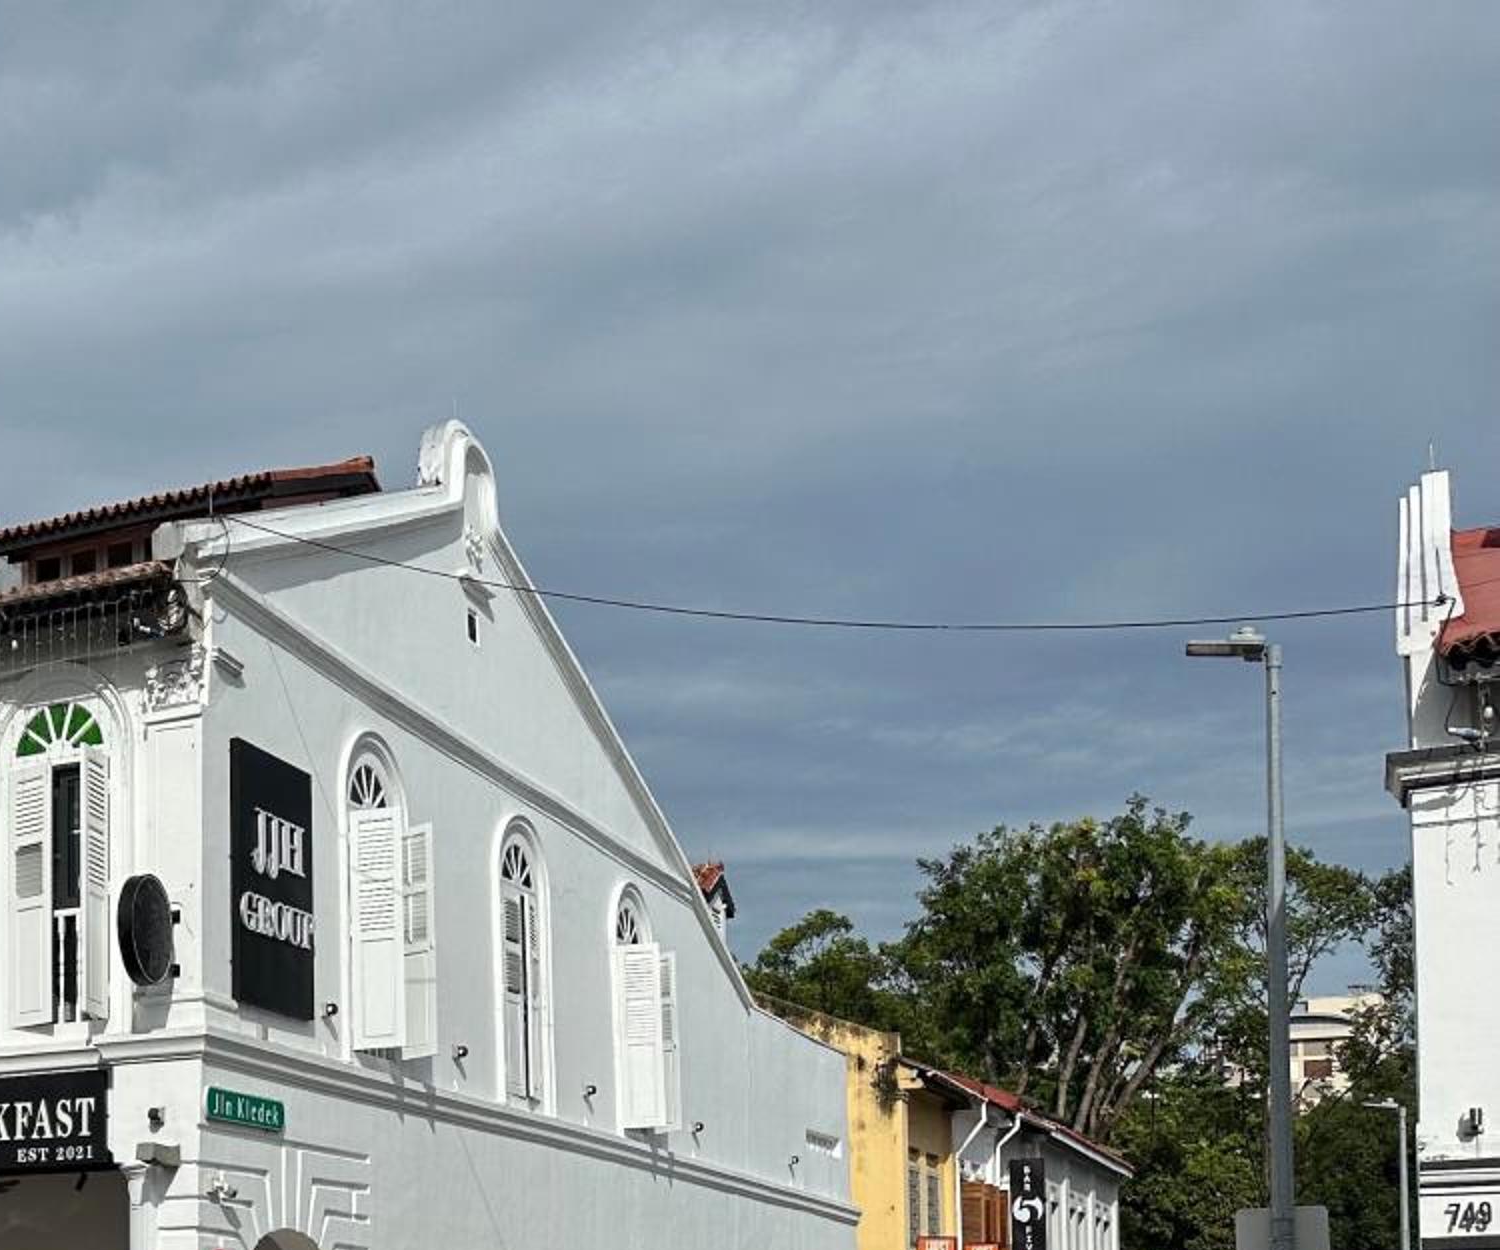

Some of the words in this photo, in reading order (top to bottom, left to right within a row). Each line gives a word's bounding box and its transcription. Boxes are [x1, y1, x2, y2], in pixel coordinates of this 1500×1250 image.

[250, 807, 306, 879] JJH
[239, 891, 315, 950] GROUP
[213, 1092, 233, 1116] Jln
[237, 1097, 279, 1126] Kledek
[16, 1147, 49, 1163] EST
[55, 1145, 94, 1161] 2021
[1445, 1201, 1493, 1230] 749
